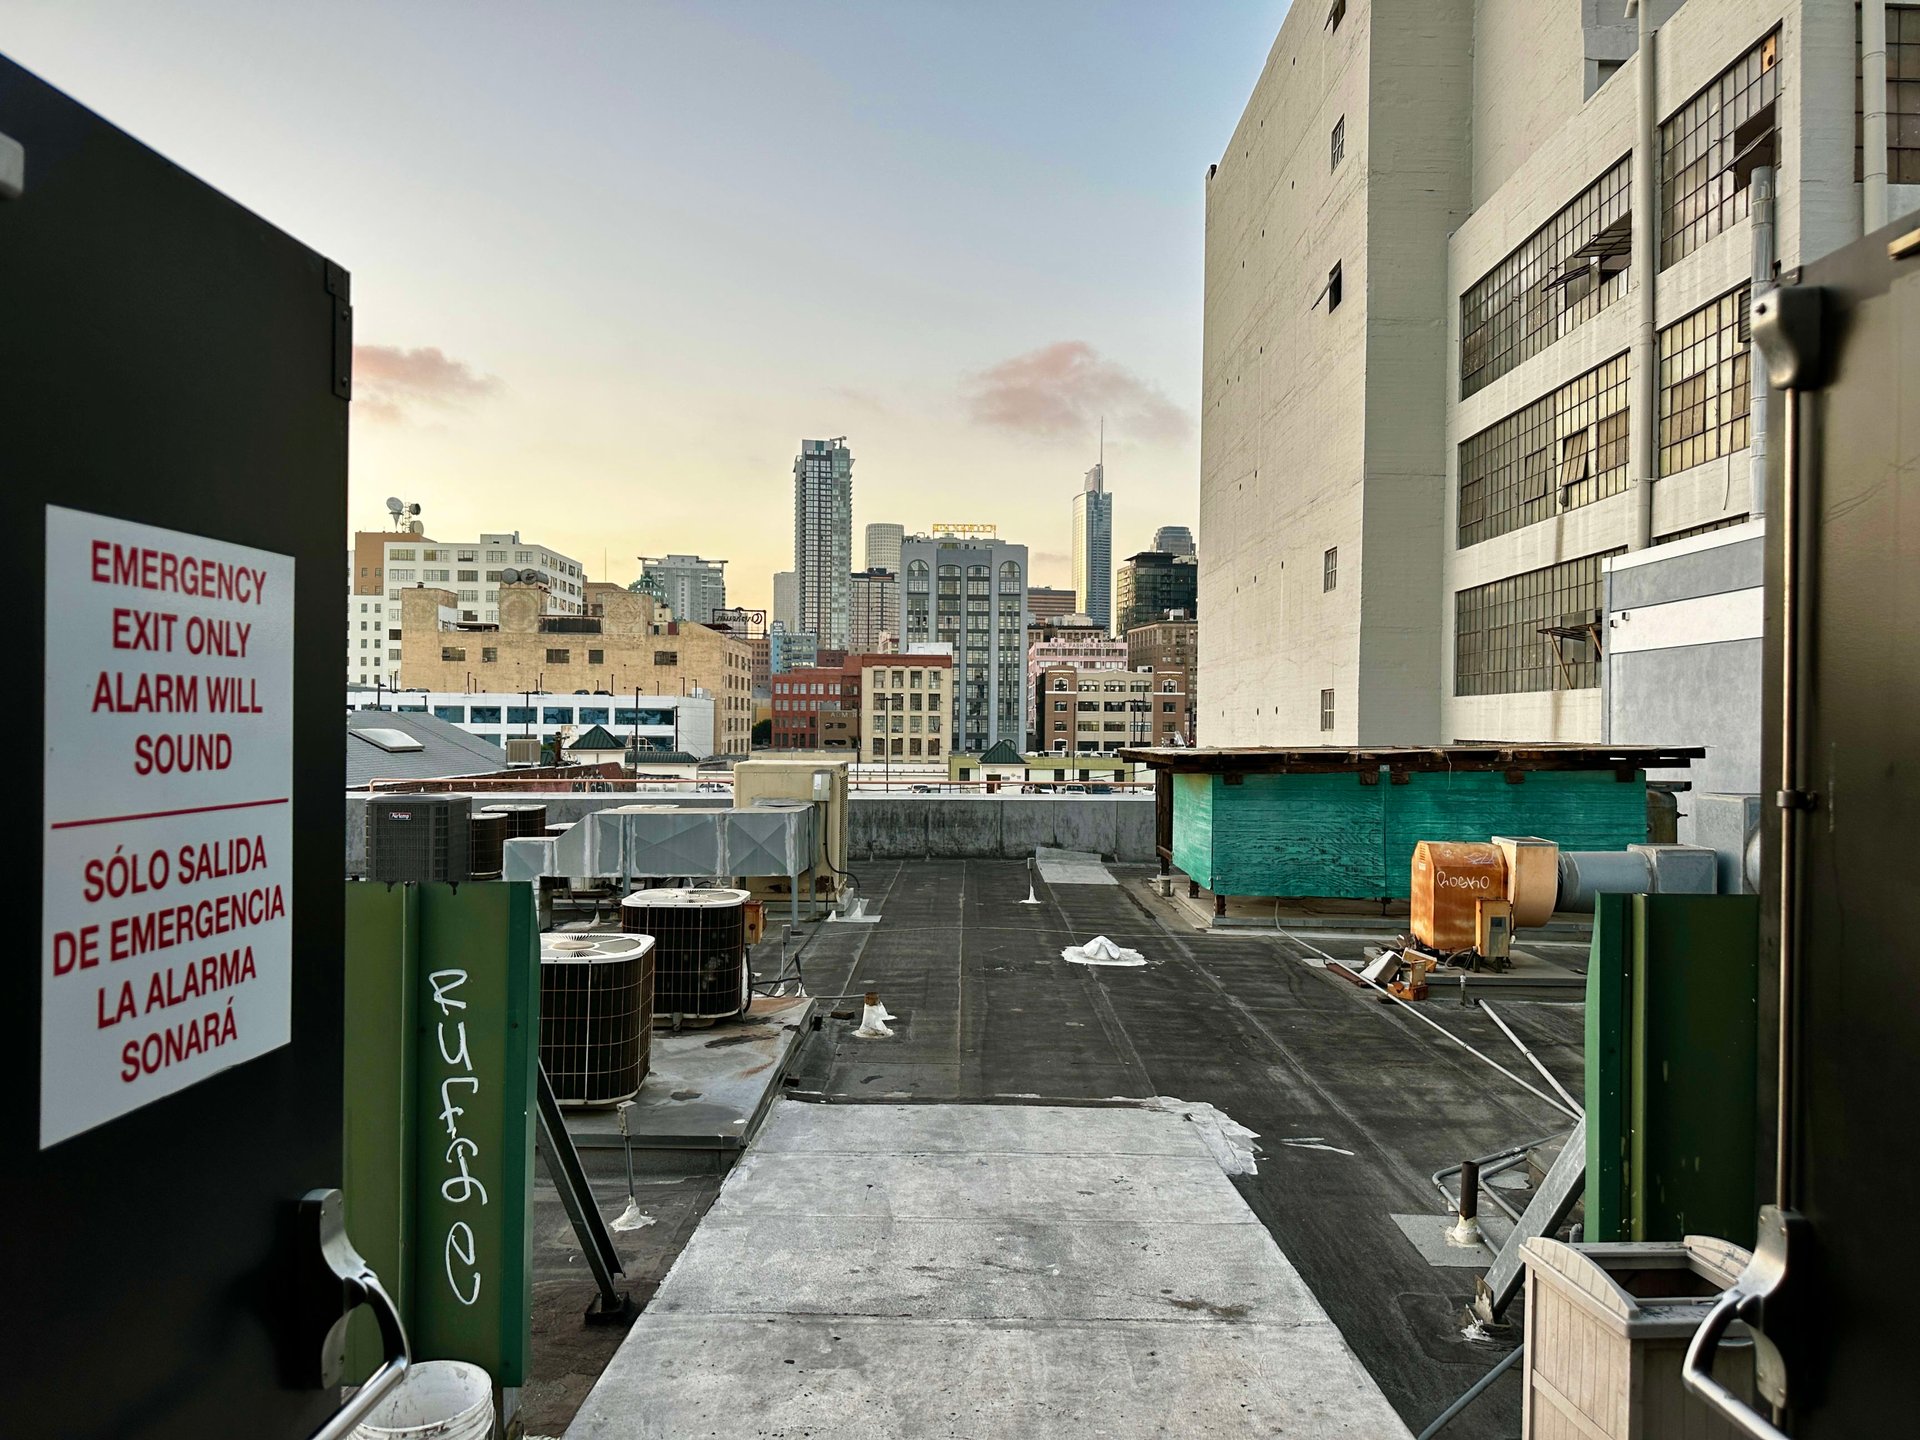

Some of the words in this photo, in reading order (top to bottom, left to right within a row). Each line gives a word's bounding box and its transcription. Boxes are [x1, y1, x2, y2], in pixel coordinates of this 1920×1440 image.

[91, 540, 267, 605] EMERGENCY
[112, 607, 178, 653] EXIT
[185, 616, 252, 658] ONLY
[91, 671, 198, 713] ALARM
[206, 677, 263, 714] WILL
[134, 733, 233, 776] SOUND
[83, 844, 170, 903] SÓLO
[178, 835, 267, 885] SALIDA
[53, 925, 100, 977] DE
[110, 885, 286, 961] EMERGENCIA
[97, 981, 137, 1029] LA
[145, 946, 257, 1014] ALARMA
[121, 997, 238, 1084] SONARÁ
